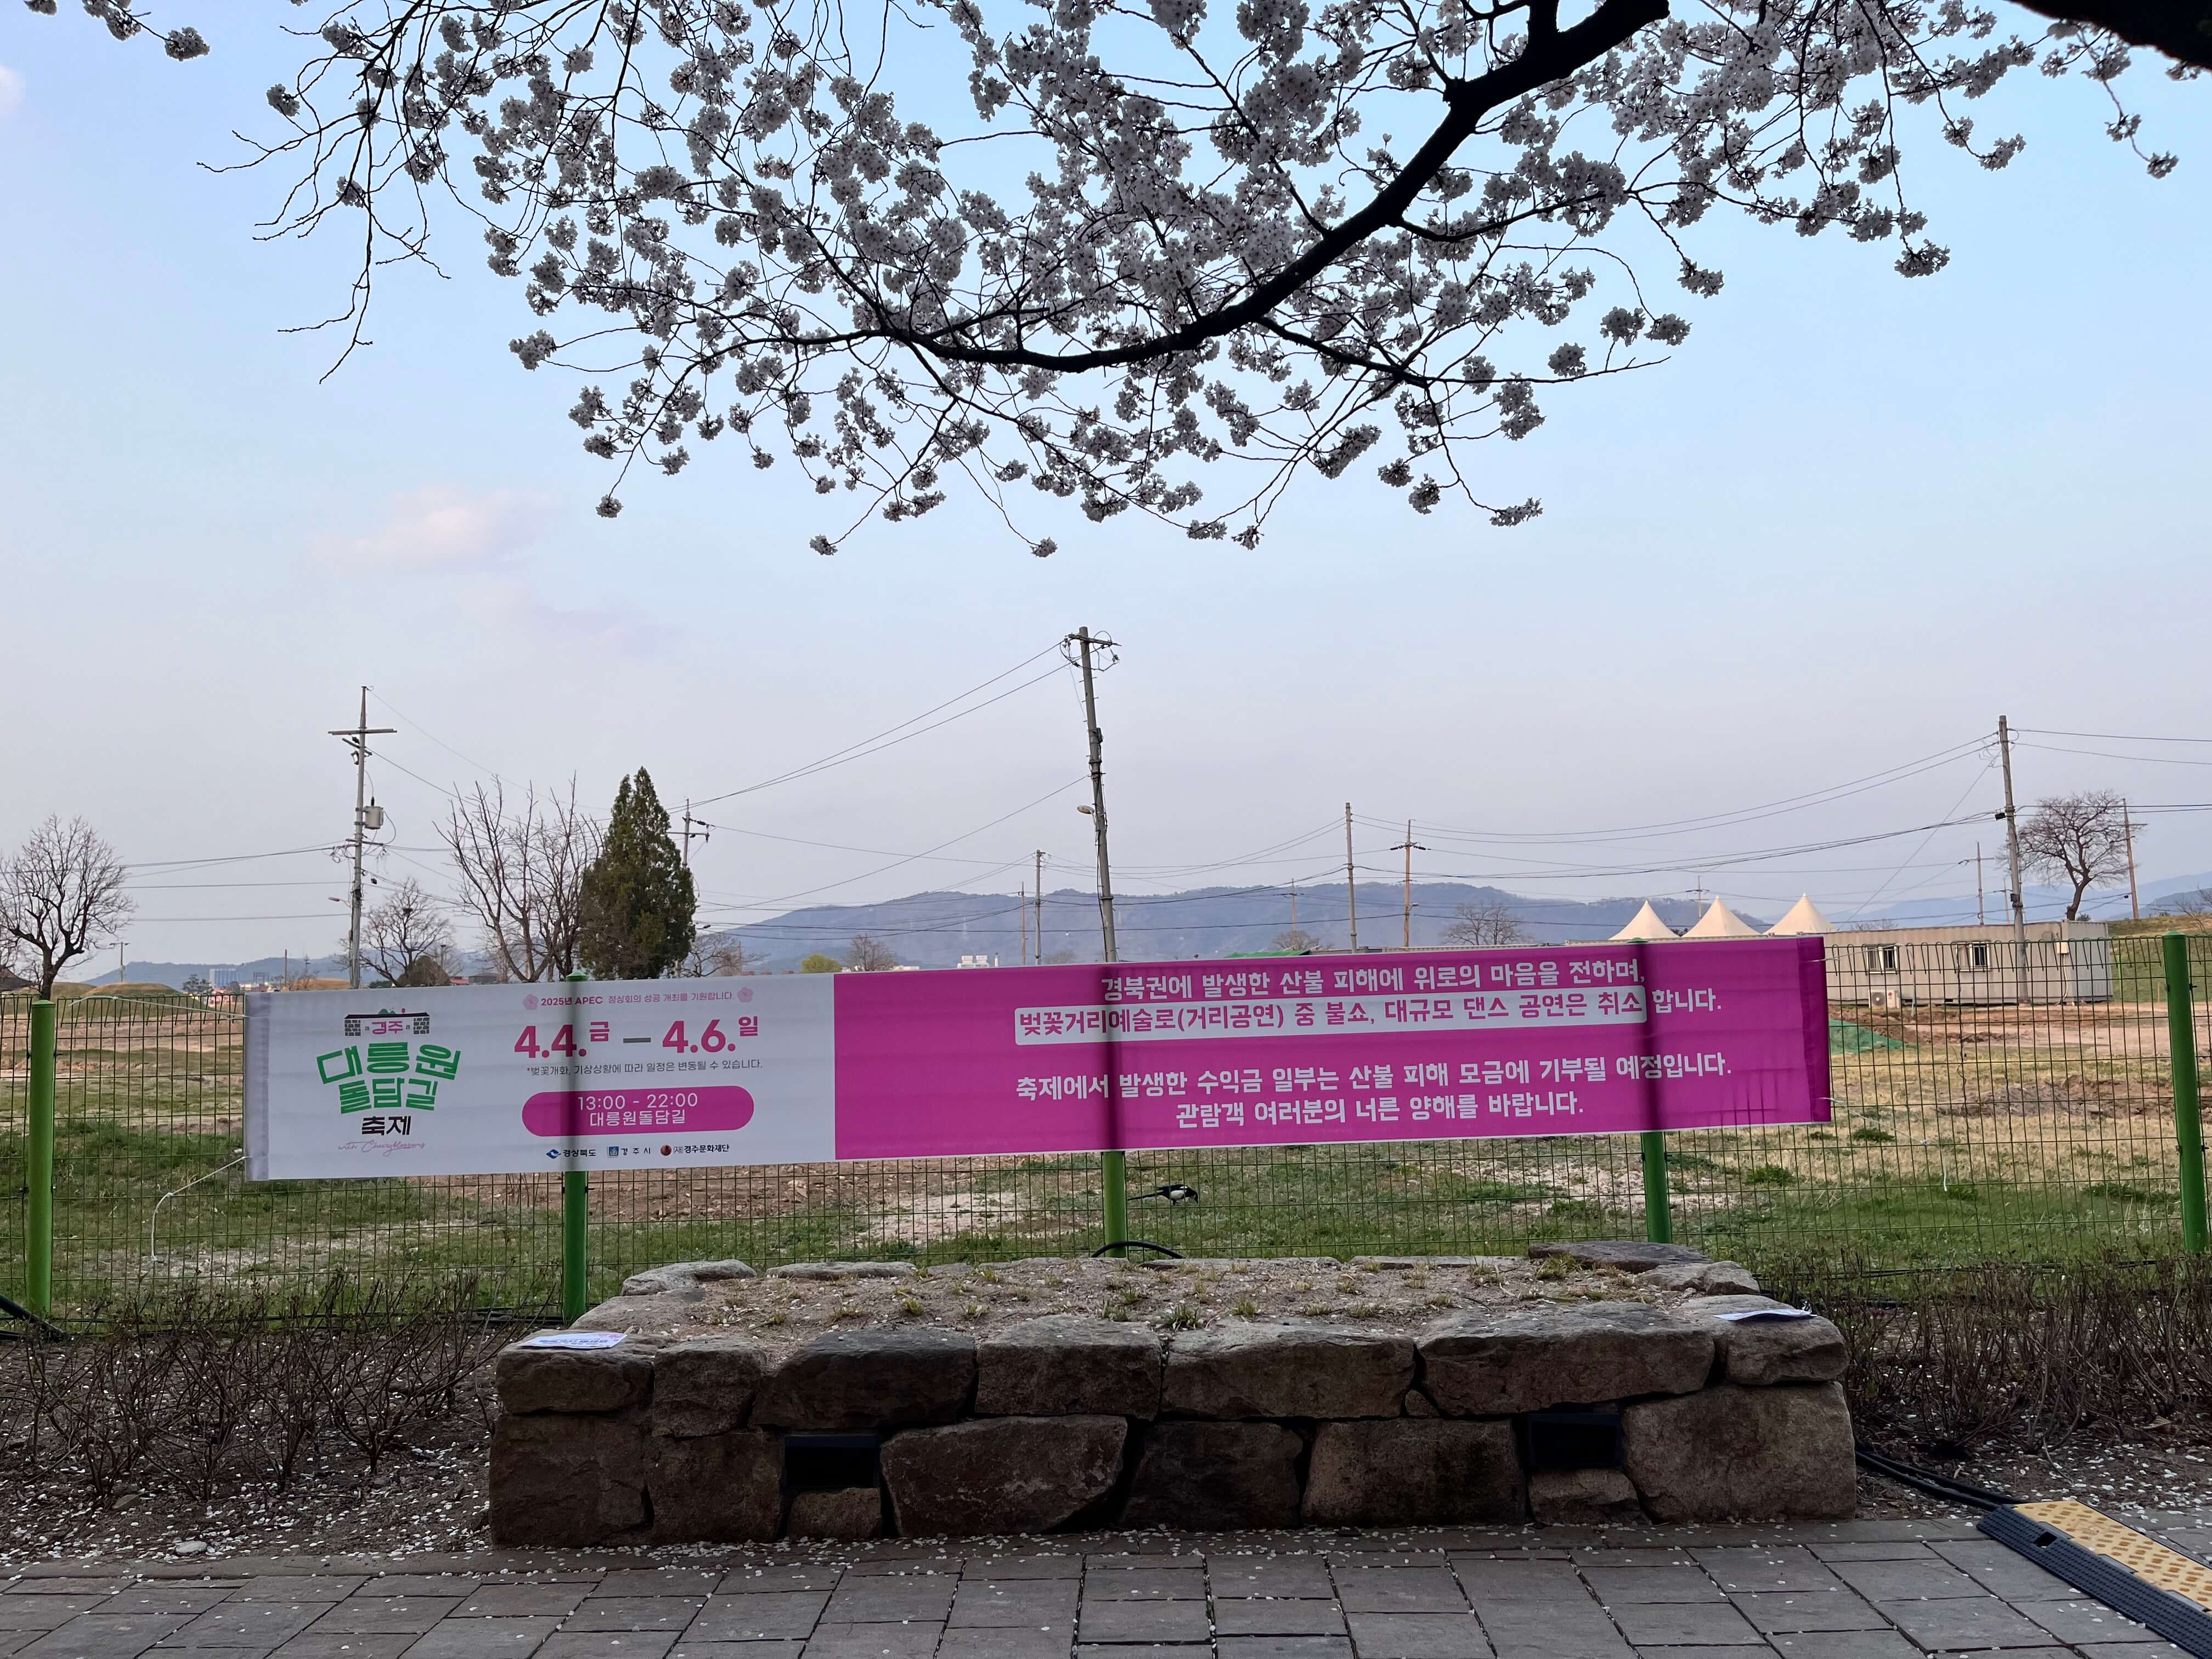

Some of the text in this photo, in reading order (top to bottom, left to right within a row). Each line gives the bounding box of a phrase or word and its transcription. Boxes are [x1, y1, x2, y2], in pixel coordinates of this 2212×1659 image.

[1101, 958, 1645, 1001] 경북권에 발생한 산불 피해에 위로의 마음을 전하며,
[541, 991, 735, 1006] 2025년 APEC 정상회의 성공 개최를 기원합니다.
[1295, 1002, 1315, 1026] 중
[1384, 998, 1454, 1023] 대규모
[1464, 996, 1509, 1020] 댄스
[1519, 993, 1587, 1018] 공연은
[1598, 991, 1643, 1015] 취소
[1651, 988, 1723, 1014] 합니다.
[372, 1021, 403, 1034] 경주
[316, 1042, 461, 1085] 대릉원
[574, 1064, 621, 1075] 기상상황에
[624, 1063, 644, 1073] 따라
[646, 1062, 675, 1072] 일정은
[678, 1060, 707, 1071] 변동될
[709, 1060, 719, 1070] 수
[722, 1059, 763, 1069] 있습니다.
[1016, 1052, 1732, 1101] 축제에서 발생한 수익금 일부는 산불 피해 모금에 기부될 예정입니다.
[338, 1077, 439, 1114] 돌담길
[579, 1094, 625, 1111] 13:00
[646, 1092, 698, 1109] 22:00
[590, 1109, 686, 1128] 대릉원돌담길
[1176, 1091, 1584, 1128] 관람객 여러분의 너른 양해를 바랍니다.
[362, 1115, 411, 1136] 축제
[563, 1148, 596, 1158] 경상북도
